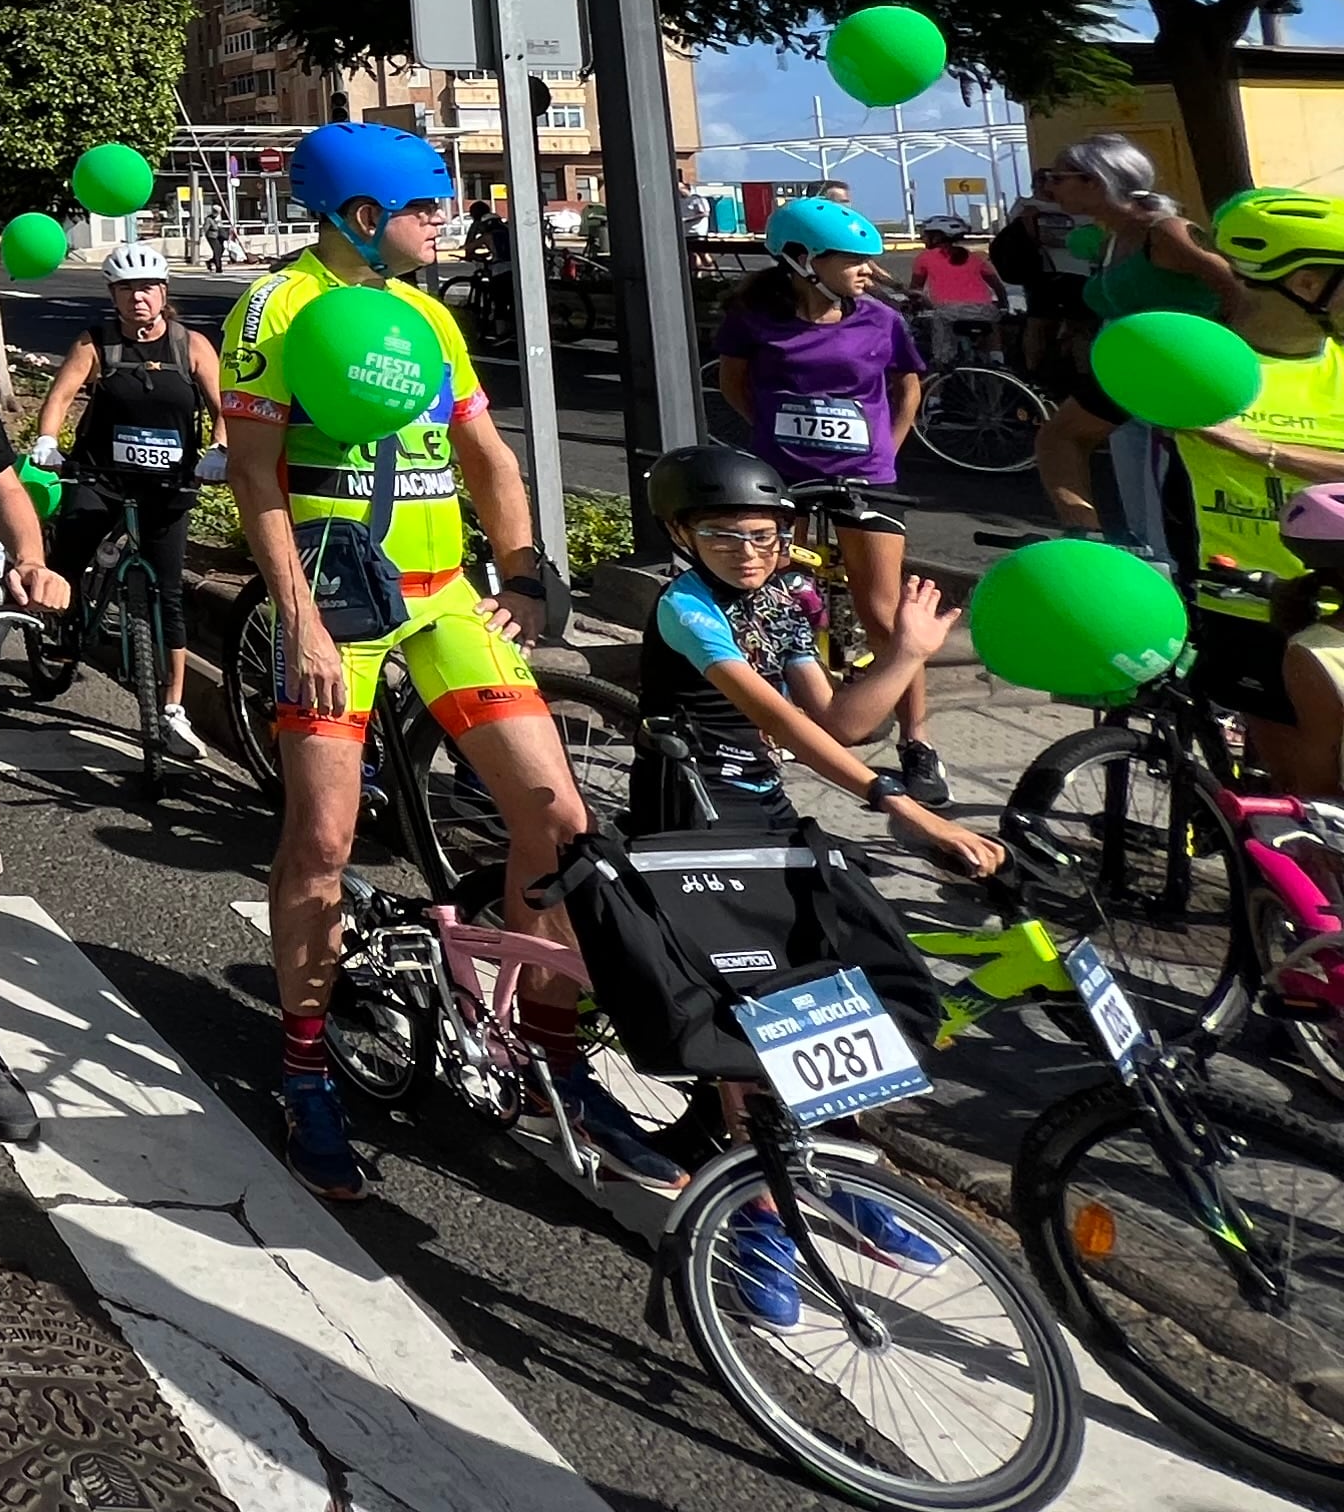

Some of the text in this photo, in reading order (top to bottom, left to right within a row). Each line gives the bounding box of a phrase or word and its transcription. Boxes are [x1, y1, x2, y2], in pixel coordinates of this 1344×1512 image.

[958, 180, 970, 193] 6
[365, 352, 421, 379] FIESTA
[347, 365, 426, 397] BICICLETA
[793, 416, 851, 440] 1752
[125, 445, 171, 466] 0358
[754, 994, 872, 1044] FIESTA BICICLETA
[792, 1028, 885, 1093] 0287
